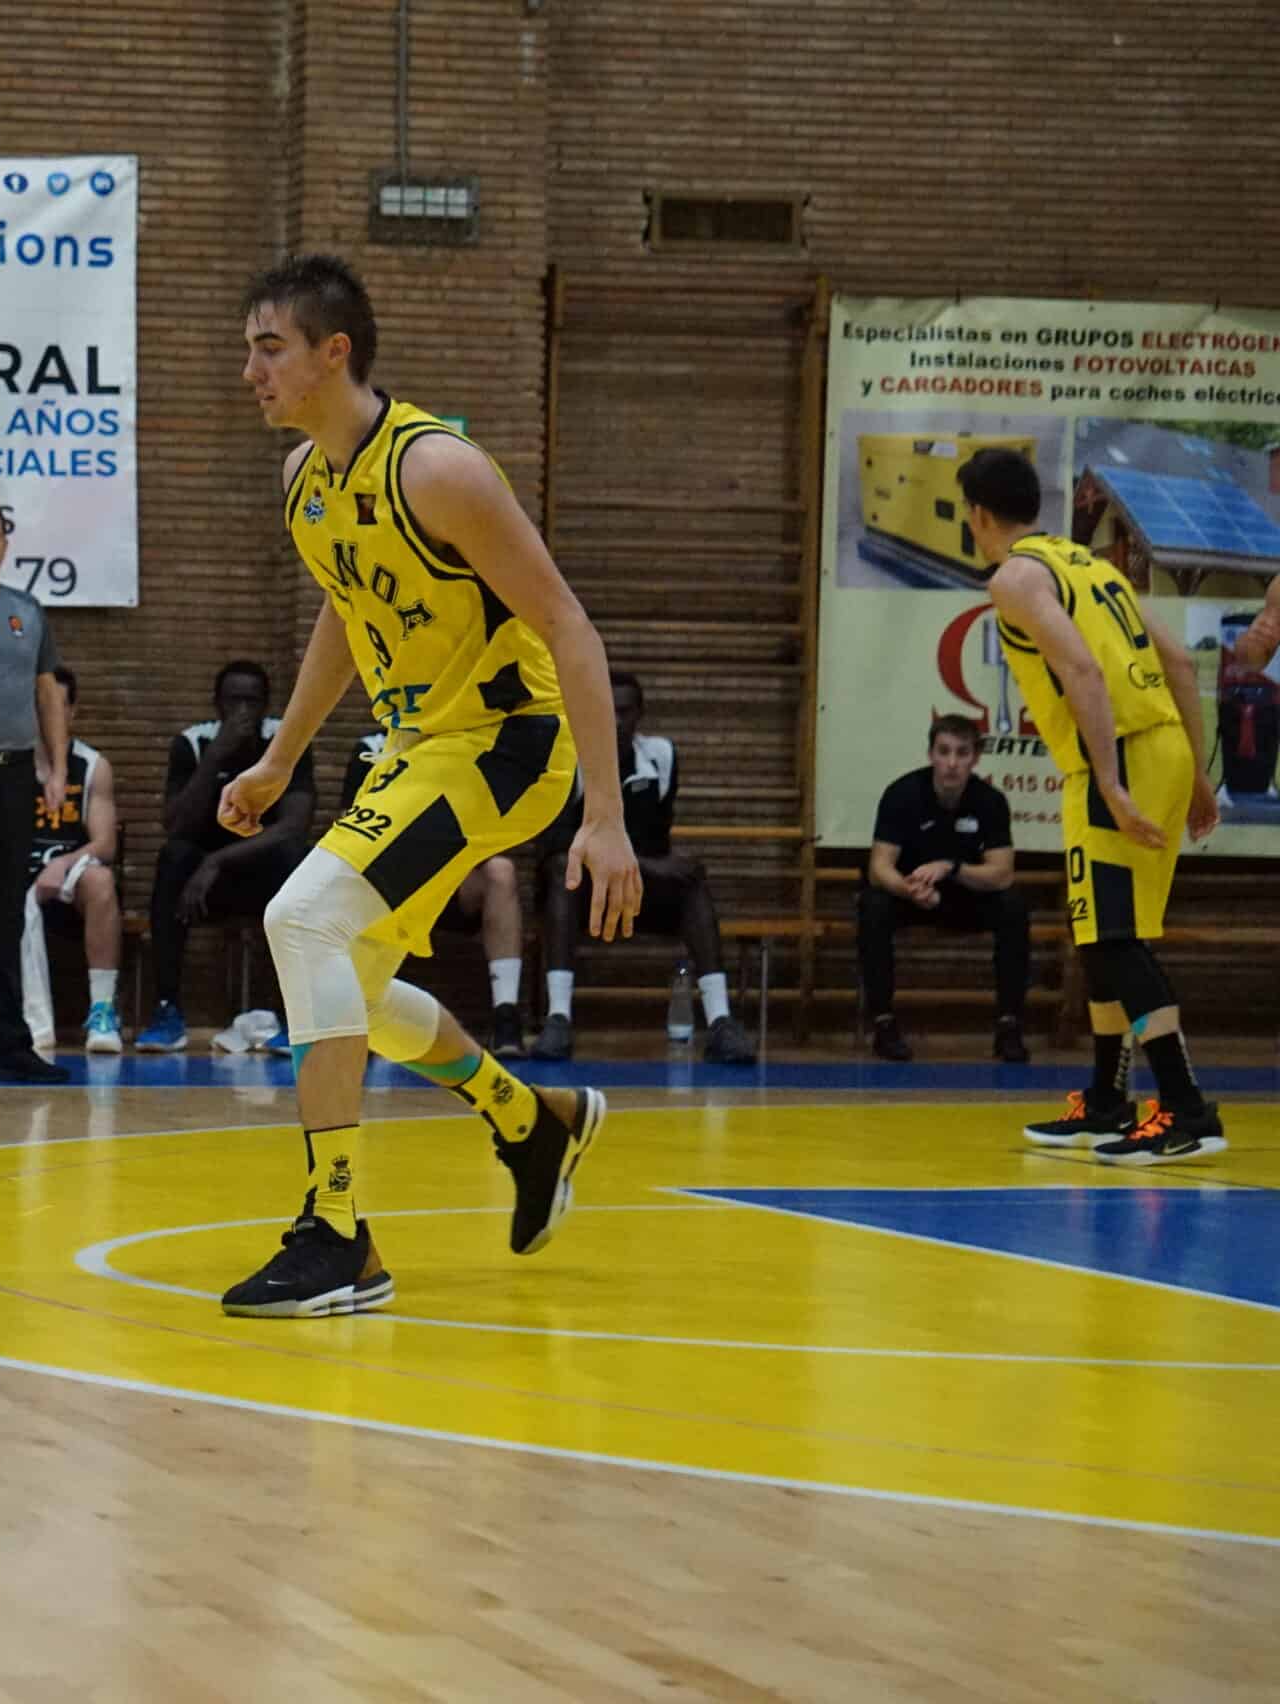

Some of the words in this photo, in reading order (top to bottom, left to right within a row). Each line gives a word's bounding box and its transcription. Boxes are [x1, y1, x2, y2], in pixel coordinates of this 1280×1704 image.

[842, 322, 992, 345] Especialistas
[1000, 329, 1028, 344] en
[1036, 328, 1134, 348] GRUPOS
[910, 351, 1065, 372] Instalaciones
[1073, 355, 1257, 378] FOTOVOLTAICAS
[861, 378, 873, 397] y
[879, 375, 1043, 398] CARGADORES
[1050, 384, 1101, 401] para
[1109, 383, 1186, 401] coches
[7, 400, 120, 437] AÑOS
[15, 557, 78, 597] 79
[1090, 581, 1150, 651] 10
